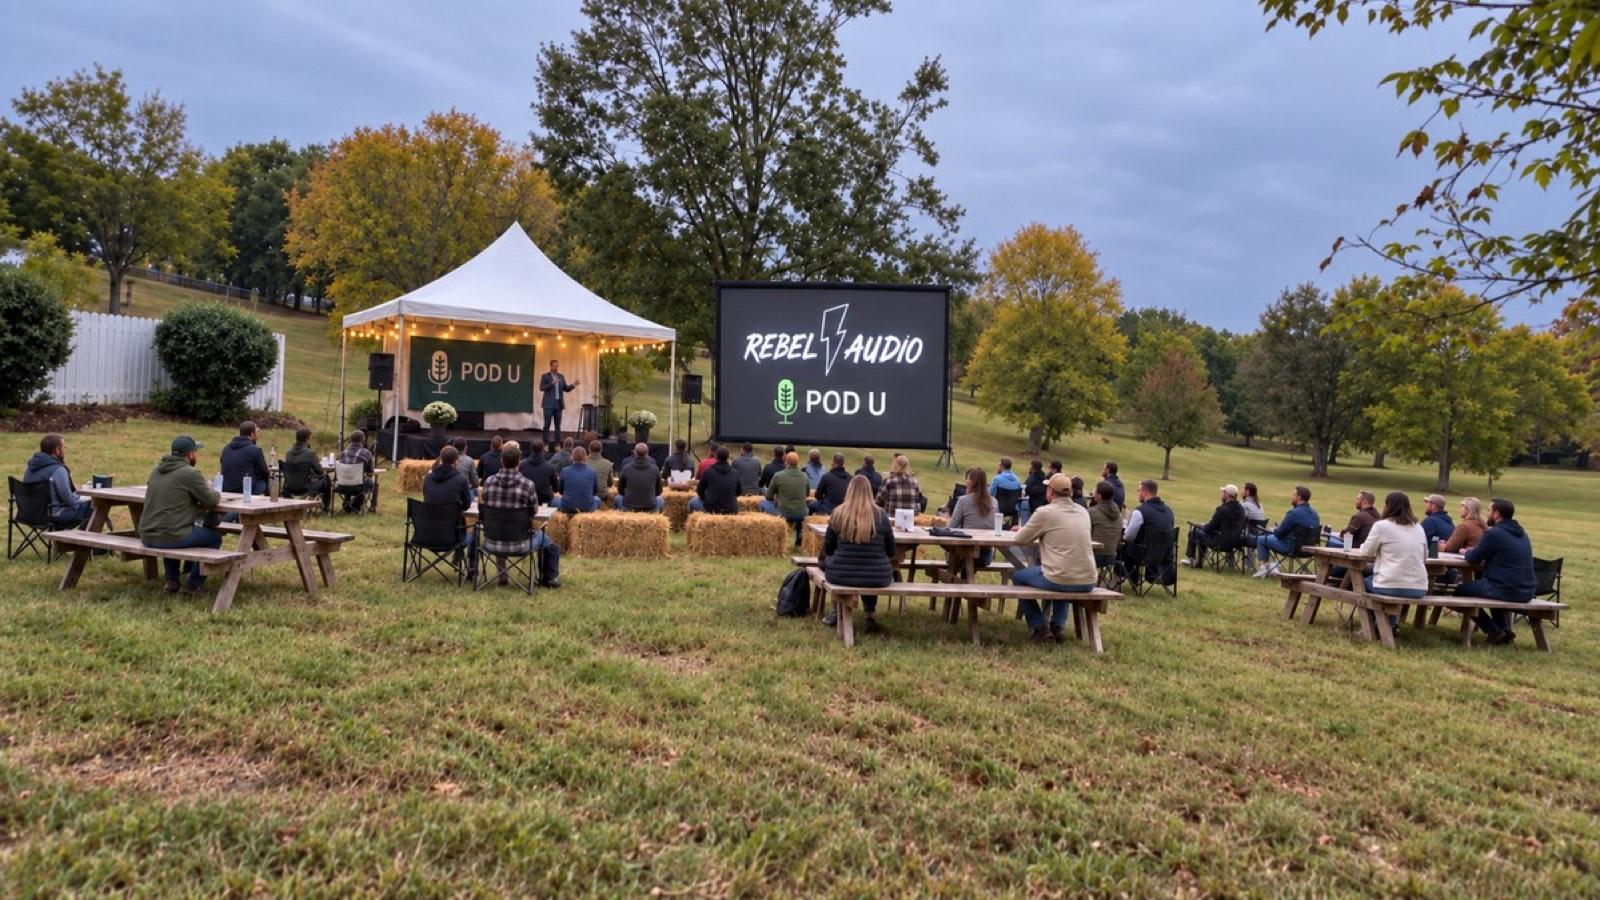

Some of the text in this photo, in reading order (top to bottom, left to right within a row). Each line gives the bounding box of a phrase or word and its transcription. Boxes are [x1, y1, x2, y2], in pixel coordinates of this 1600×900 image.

[743, 332, 818, 364] REBEL
[461, 362, 520, 383] POD U
[806, 389, 887, 417] POD U
